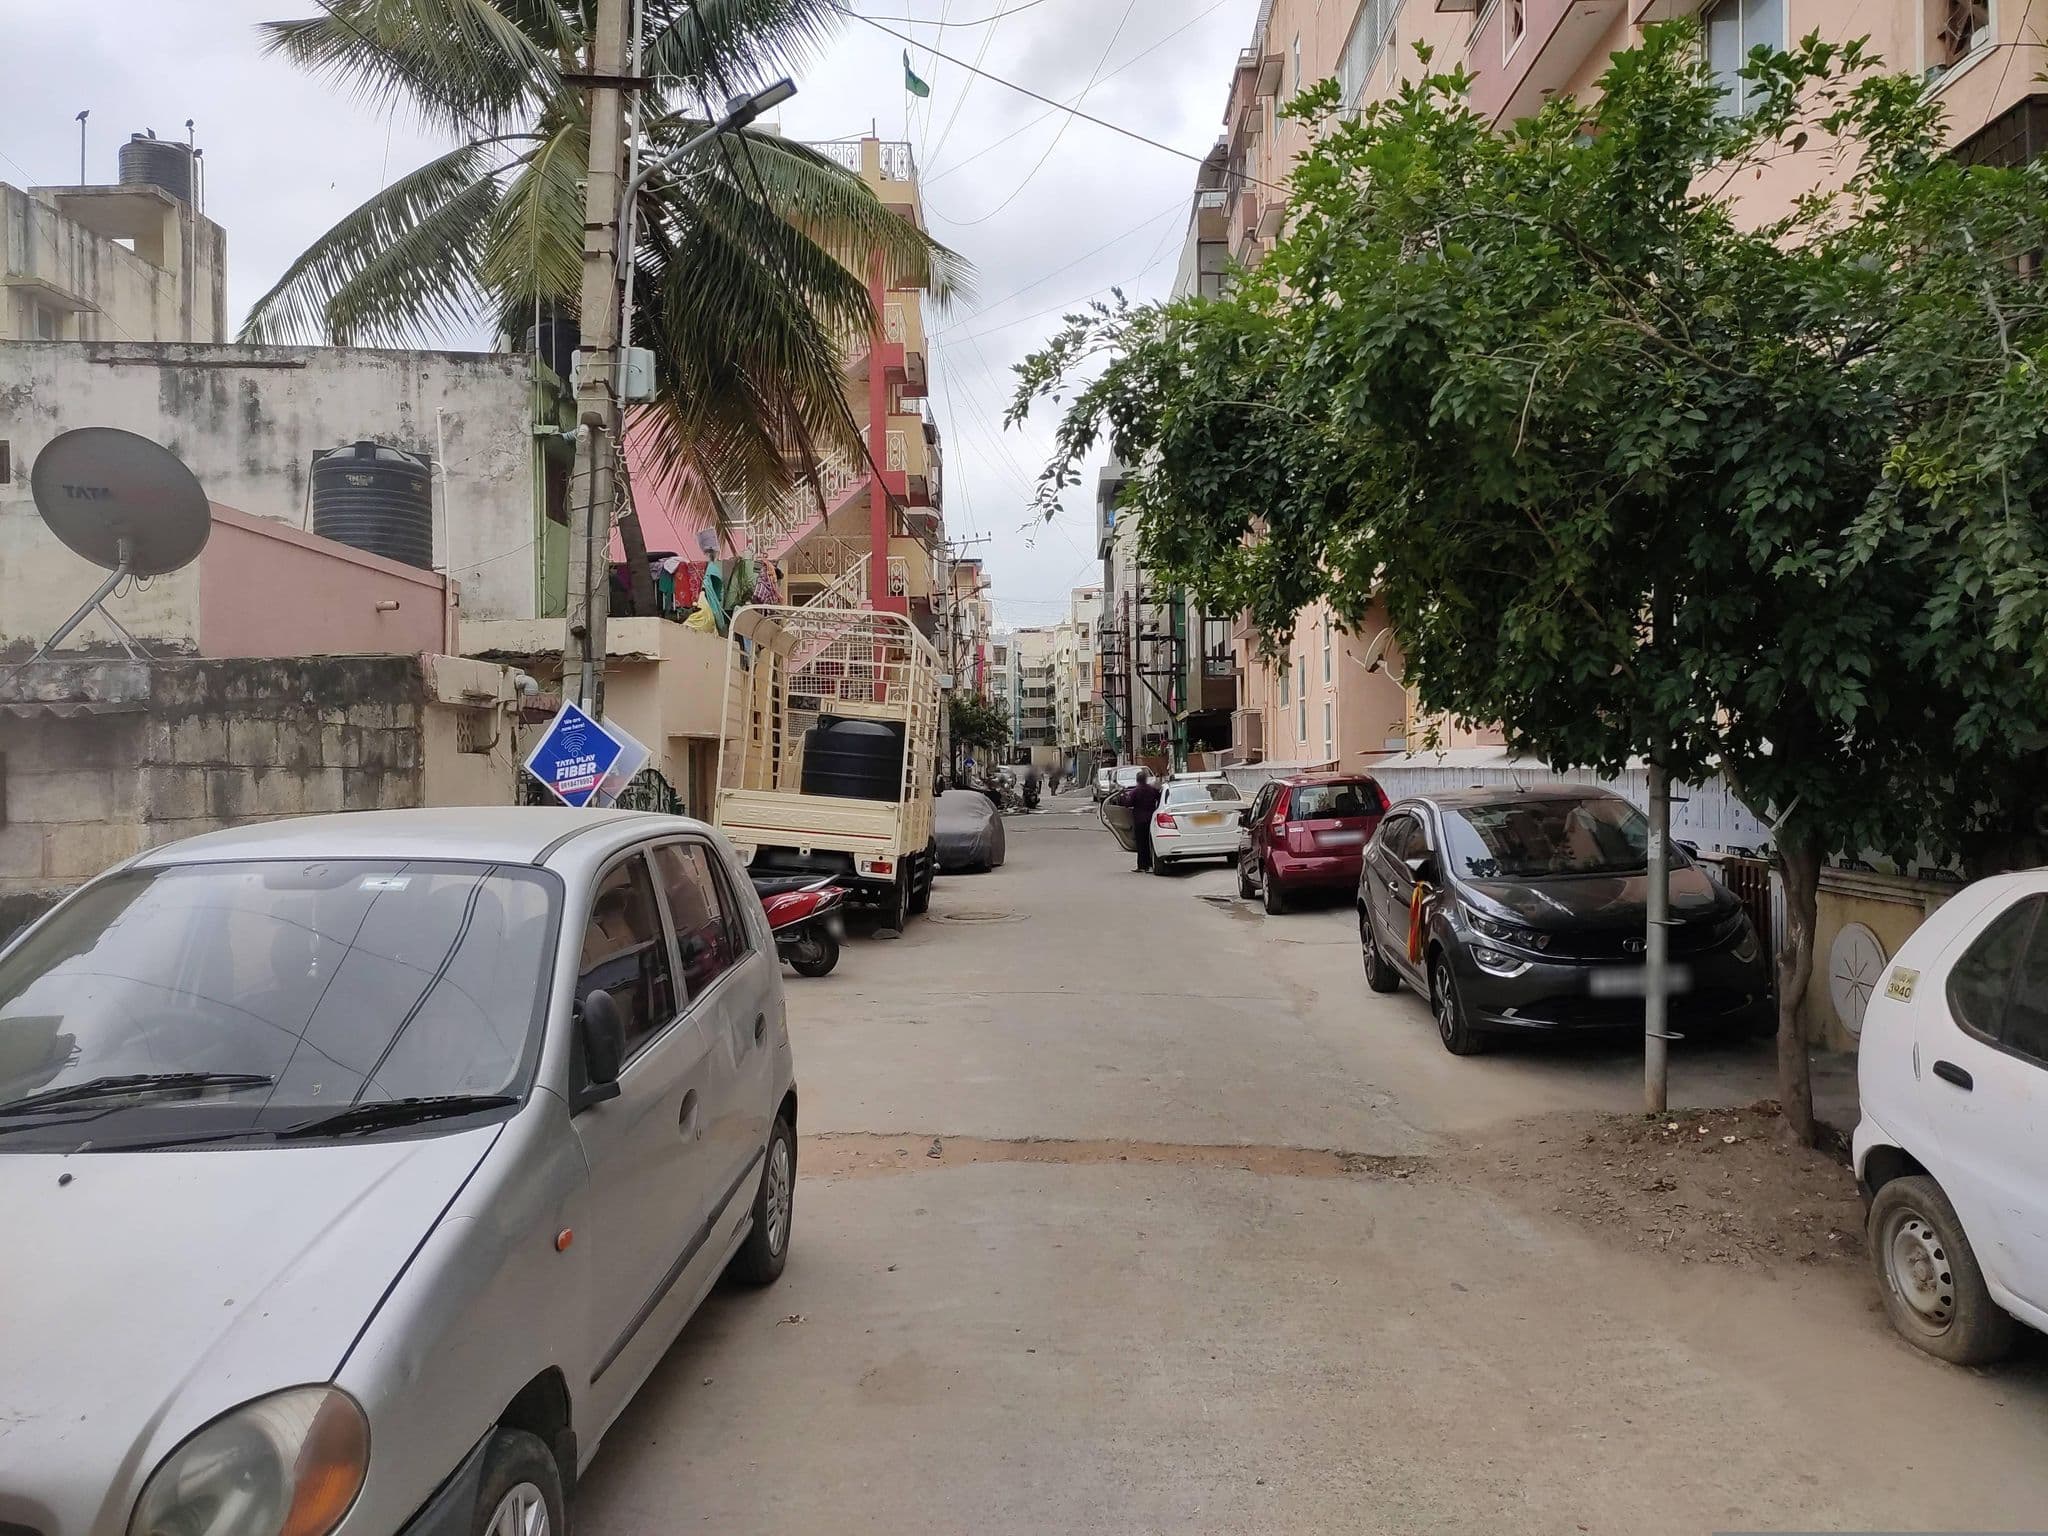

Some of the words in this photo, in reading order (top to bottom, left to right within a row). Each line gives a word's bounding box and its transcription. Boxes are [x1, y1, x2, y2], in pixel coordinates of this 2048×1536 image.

[63, 485, 113, 500] TATA
[555, 759, 575, 768] TATA
[576, 753, 596, 764] PLAY
[556, 762, 596, 780] FIBER
